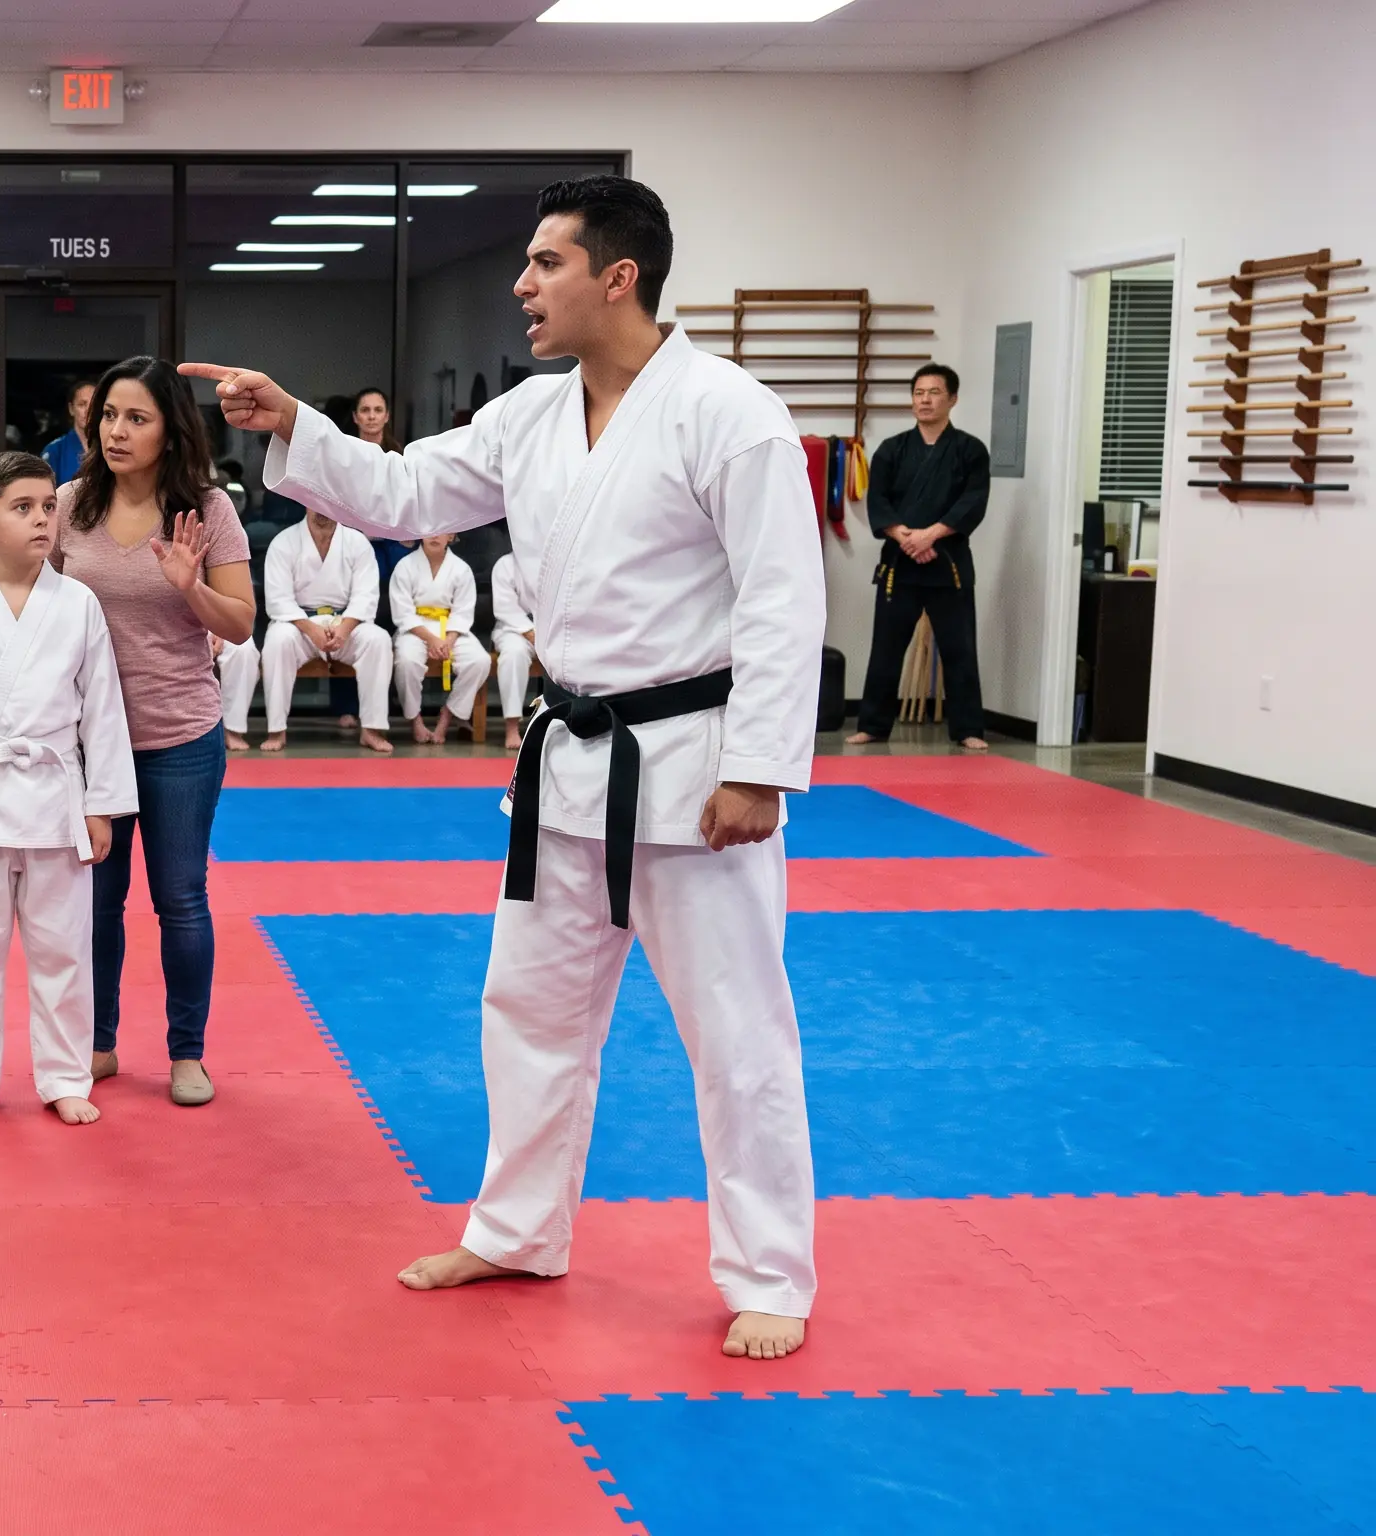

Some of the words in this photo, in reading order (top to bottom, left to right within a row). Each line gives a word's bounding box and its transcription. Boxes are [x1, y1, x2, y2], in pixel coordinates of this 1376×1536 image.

[63, 73, 112, 109] EXIT
[49, 237, 96, 258] TUES
[99, 238, 110, 258] 5
